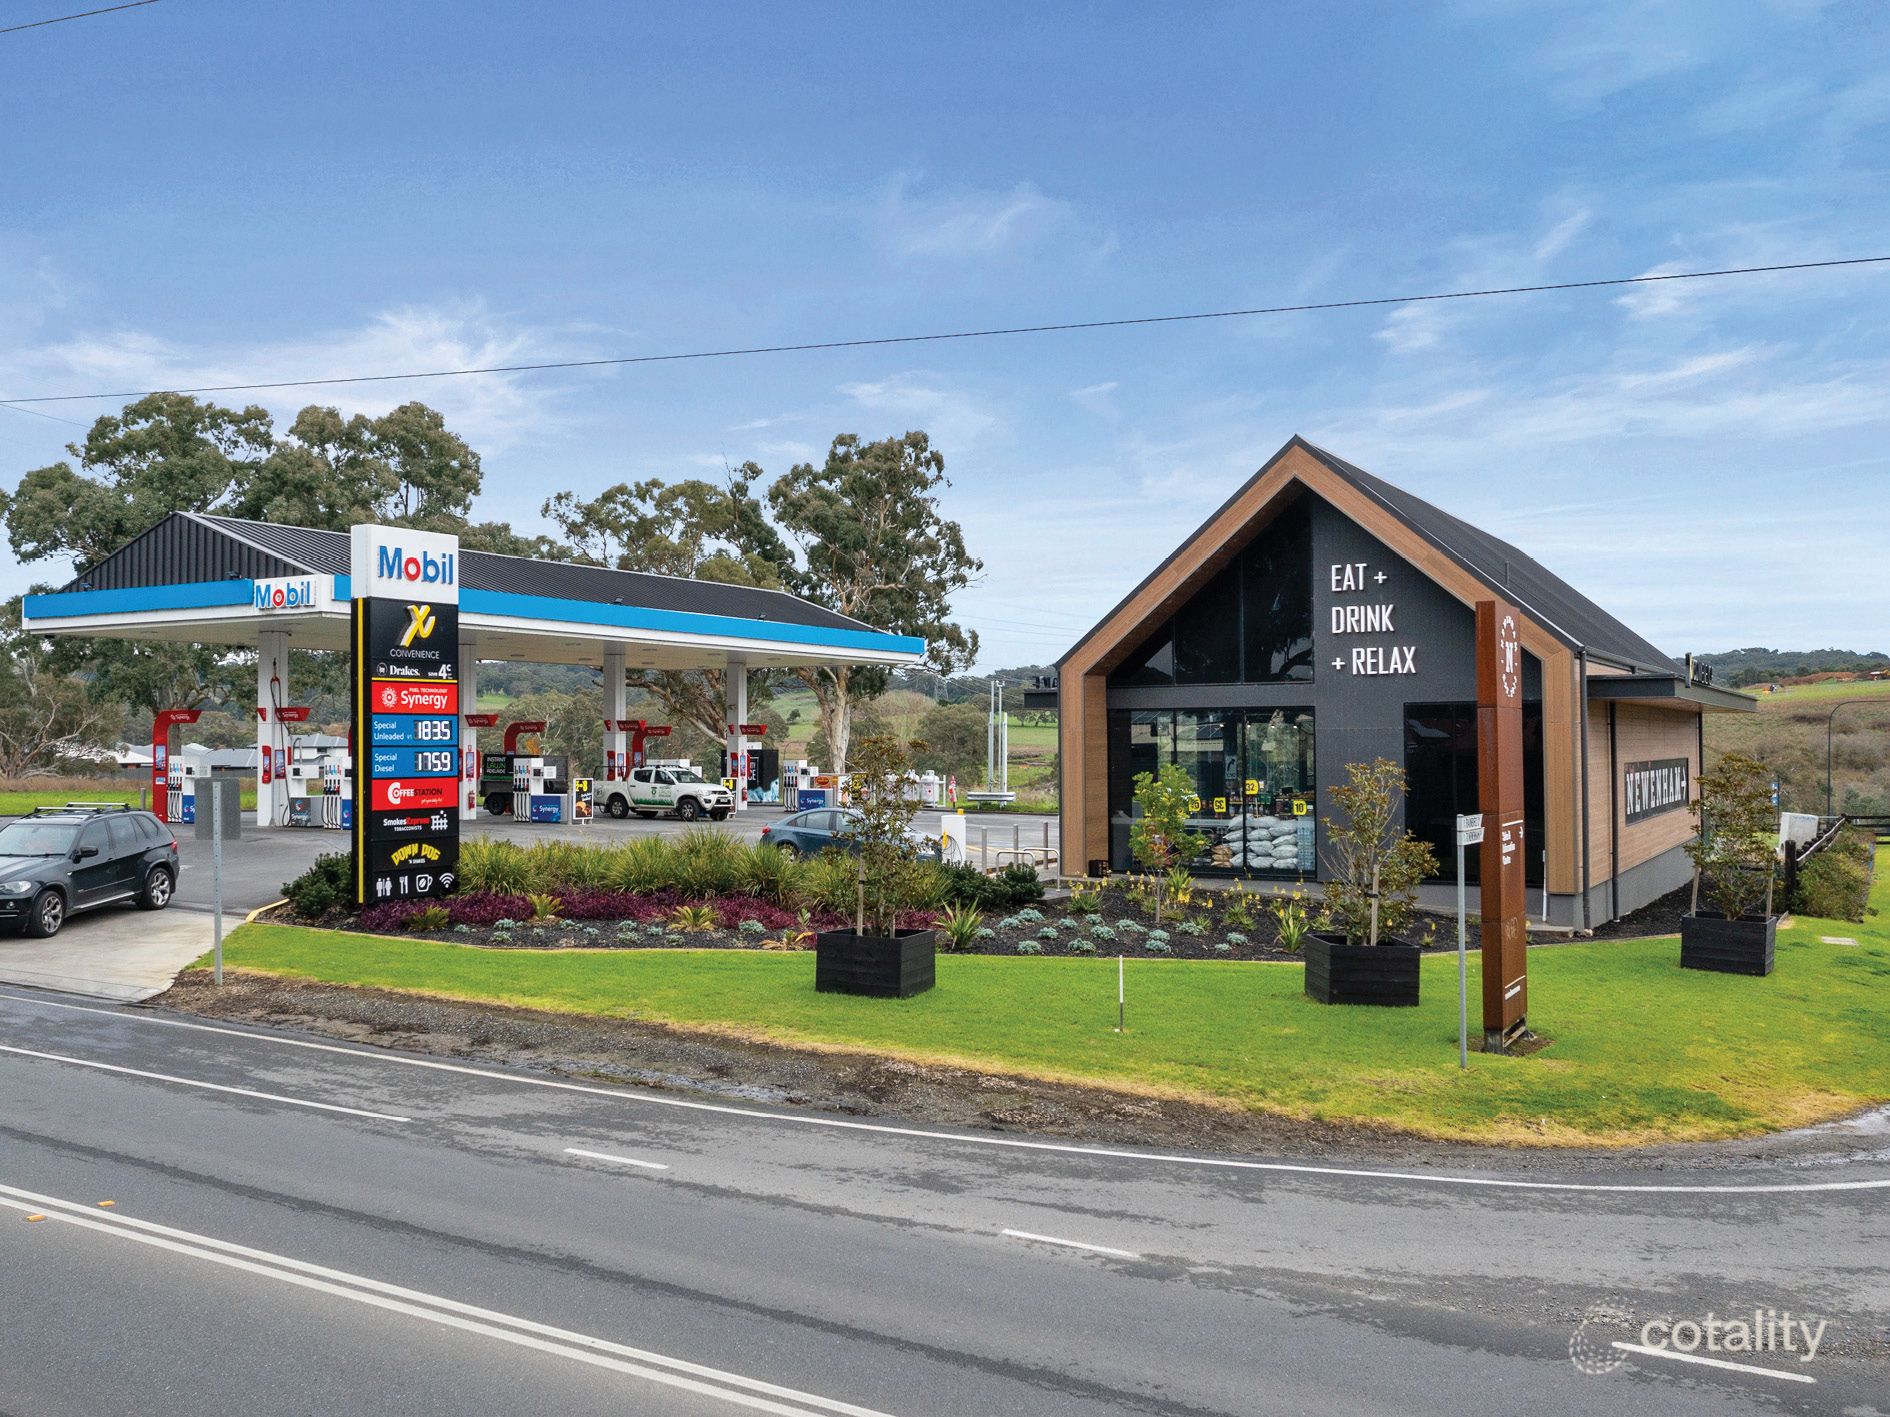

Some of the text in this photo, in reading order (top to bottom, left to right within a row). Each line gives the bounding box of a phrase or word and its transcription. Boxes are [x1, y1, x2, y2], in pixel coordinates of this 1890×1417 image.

[378, 545, 454, 585] Mobil
[1331, 563, 1368, 592] EAT
[255, 581, 310, 608] Mobil
[1331, 604, 1395, 634] DRINK
[389, 648, 440, 659] CONVENIENCE
[1352, 646, 1416, 675] RELAX
[401, 690, 448, 709] Synergy
[373, 720, 397, 731] Special
[373, 732, 405, 740] Unleaded
[374, 753, 398, 763] Special
[374, 764, 395, 772] Diesel
[1626, 766, 1681, 815] NEWENHAM
[1295, 803, 1304, 812] 10
[391, 843, 441, 866] DOWN DOG
